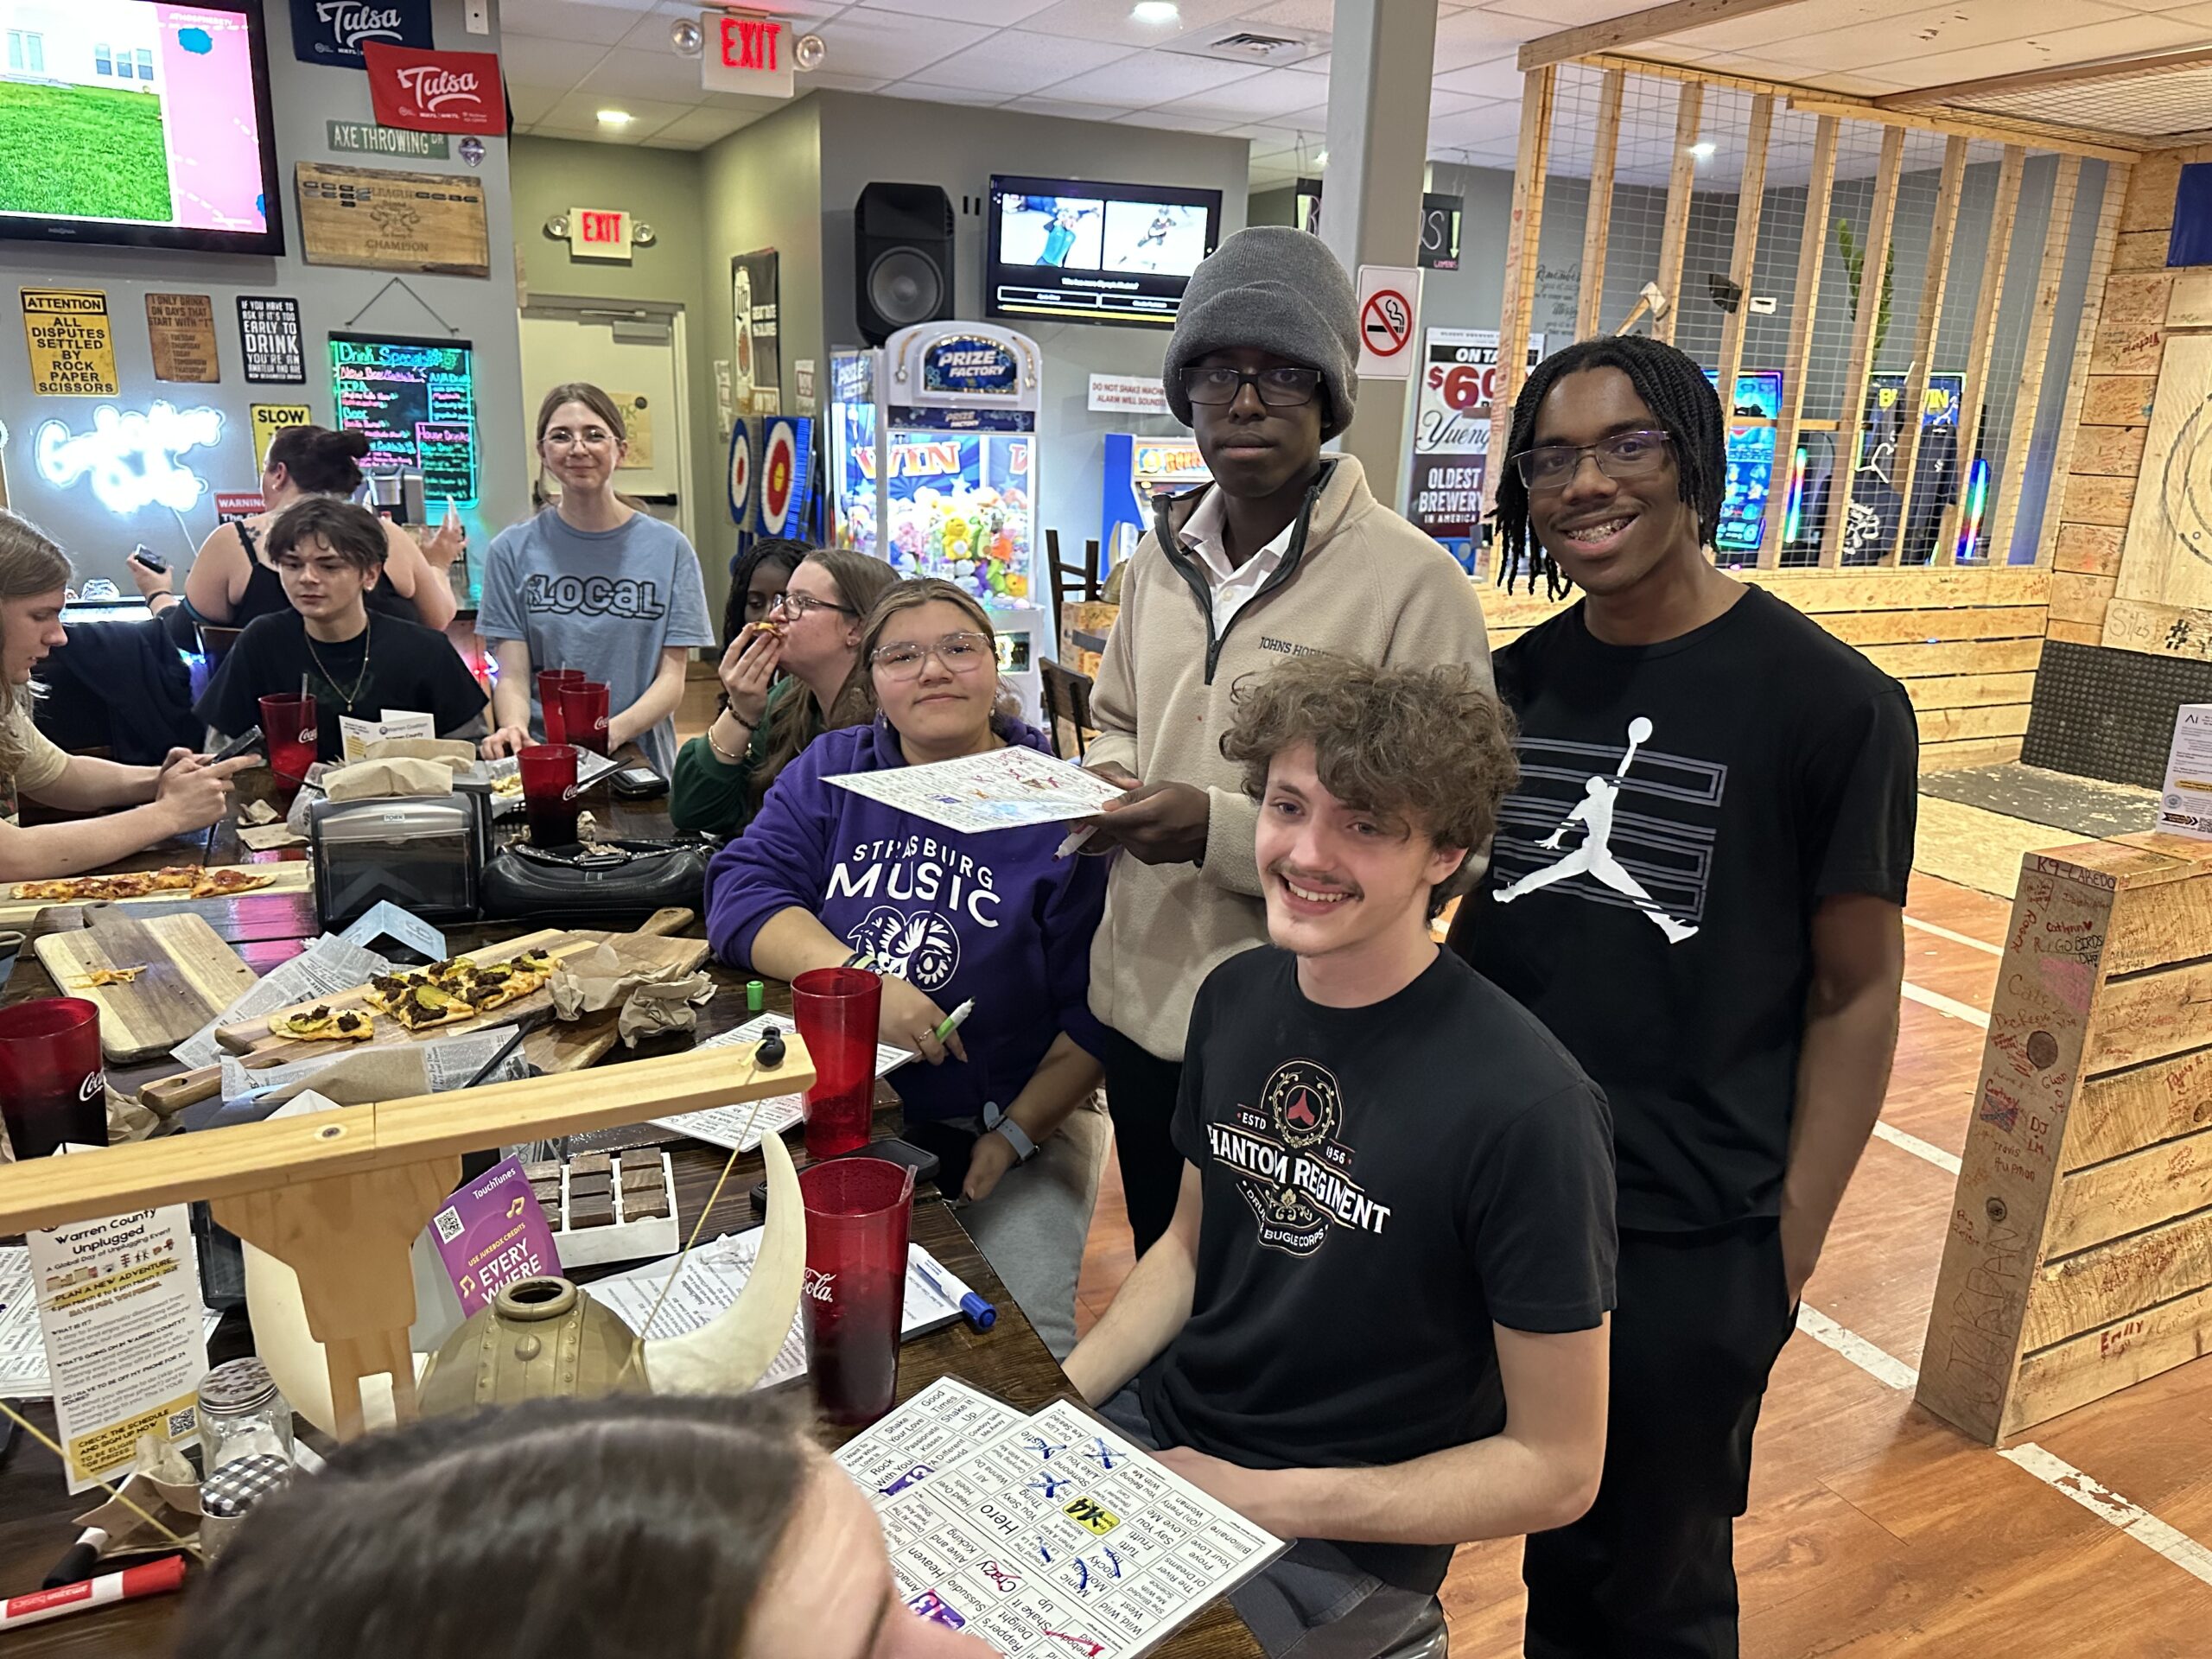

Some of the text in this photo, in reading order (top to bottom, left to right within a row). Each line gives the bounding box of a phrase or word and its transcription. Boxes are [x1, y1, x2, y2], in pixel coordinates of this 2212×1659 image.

[316, 1, 402, 43] Tulsa
[720, 17, 781, 71] EXIT
[397, 67, 479, 109] Tulsa
[334, 125, 445, 156] AXE THROWING DR
[582, 211, 623, 245] EXIT
[365, 239, 429, 252] CHAMPION
[28, 297, 101, 310] ATTENTION
[151, 306, 207, 317] ON DAYS THAT
[157, 296, 205, 307] ONLY DRINK
[241, 301, 295, 312] IF YOU HAVE TO
[54, 317, 81, 327] ALL
[149, 317, 197, 327] START WITH
[242, 310, 257, 320] ASK
[258, 311, 264, 320] IF
[282, 311, 296, 321] TOO
[31, 327, 105, 339] DISPUTES
[244, 321, 297, 335] EARLY TO
[37, 338, 104, 350] SETTLED
[62, 350, 82, 360] BY
[245, 334, 300, 354] DRINK
[339, 341, 375, 363] Drink
[1455, 348, 1498, 362] ON TA
[53, 360, 95, 372] ROCK
[246, 353, 300, 365] YOU'RE AN
[938, 349, 998, 367] PRIZE
[49, 372, 100, 383] PAPER
[949, 365, 1007, 378] FACTORY
[39, 382, 114, 393] SCISSORS
[1092, 382, 1141, 394] DO NOT SHAKE
[257, 409, 305, 423] SLOW
[945, 410, 976, 422] PRIZE
[851, 442, 961, 479] WIN
[1427, 467, 1482, 489] OLDEST
[1418, 491, 1484, 513] BREWERY
[1424, 513, 1476, 524] IN AMERICA
[1258, 637, 1293, 654] JOHNS
[853, 835, 994, 891] STRASBURG
[825, 861, 1001, 928] MUSIC
[2075, 935, 2103, 951] BIRDS
[1242, 1111, 1267, 1130] ESTD
[2031, 1116, 2049, 1135] DJ
[1207, 1123, 1289, 1185] HANTOM
[1325, 1145, 1346, 1165] 1956
[472, 1167, 517, 1200] TouchTunes
[1295, 1157, 1391, 1234] REGIMENT
[55, 1208, 157, 1245] Warren County
[54, 1227, 171, 1271] Global Unplugging Event
[72, 1224, 145, 1255] Unplugged
[467, 1222, 526, 1268] USE JUKEBOX CREDITS
[1263, 1230, 1325, 1247] BUGLE CORPS
[479, 1237, 529, 1287] EVERY
[54, 1258, 173, 1301] PLAN NEW ADVENTURE
[480, 1254, 542, 1306] WHERE
[920, 1389, 945, 1408] Good
[930, 1395, 958, 1414] Times
[940, 1404, 968, 1424] Shake
[961, 1411, 977, 1423] Up
[79, 1408, 170, 1448] CHECK THE SCHEDULE
[884, 1416, 909, 1435] Shake
[888, 1417, 925, 1445] Your Love
[968, 1421, 991, 1438] Cowboy
[1044, 1421, 1060, 1433] Lips
[1049, 1414, 1085, 1440] Are Sealed
[79, 1435, 122, 1456] AND SIGN
[904, 1425, 941, 1452] Passionate
[920, 1434, 944, 1452] Kisses
[936, 1438, 967, 1462] Different
[869, 1458, 895, 1477] Rock
[974, 1458, 1009, 1485] Wanna Do
[1065, 1454, 1084, 1469] You
[873, 1470, 897, 1488] With
[1053, 1459, 1090, 1487] Someone
[936, 1478, 972, 1508] Head Over
[954, 1478, 976, 1495] Heels
[1118, 1471, 1155, 1499] You Belong
[1000, 1492, 1039, 1522] You Sexy
[1018, 1488, 1044, 1510] Thing
[1160, 1497, 1185, 1517] Pretty
[1174, 1496, 1205, 1519] Woman
[979, 1503, 1020, 1536] Hero
[1146, 1509, 1188, 1540] Love Me
[945, 1527, 979, 1554] Kicking
[1127, 1529, 1156, 1552] Frutti
[1135, 1516, 1175, 1546] Say You
[1210, 1524, 1253, 1555] Billionaire
[929, 1533, 968, 1564] Alive and
[1117, 1539, 1141, 1560] Tutti
[1189, 1538, 1231, 1570] Your Love
[907, 1546, 946, 1579] Heaven
[1165, 1555, 1199, 1582] Dreams
[1187, 1549, 1215, 1572] Prove
[976, 1559, 1017, 1593] Crazy
[1156, 1564, 1179, 1584] River
[11, 1585, 89, 1611] amazon basics
[947, 1579, 987, 1613] Sussudio
[1127, 1586, 1152, 1605] Blinded
[1148, 1579, 1176, 1599] Science
[1037, 1599, 1055, 1614] Up
[1119, 1600, 1143, 1621] West
[996, 1610, 1034, 1642] Delight
[1020, 1605, 1053, 1631] Shake
[1097, 1602, 1143, 1636] Wild, Wild
[981, 1616, 1024, 1652] Rapper's
